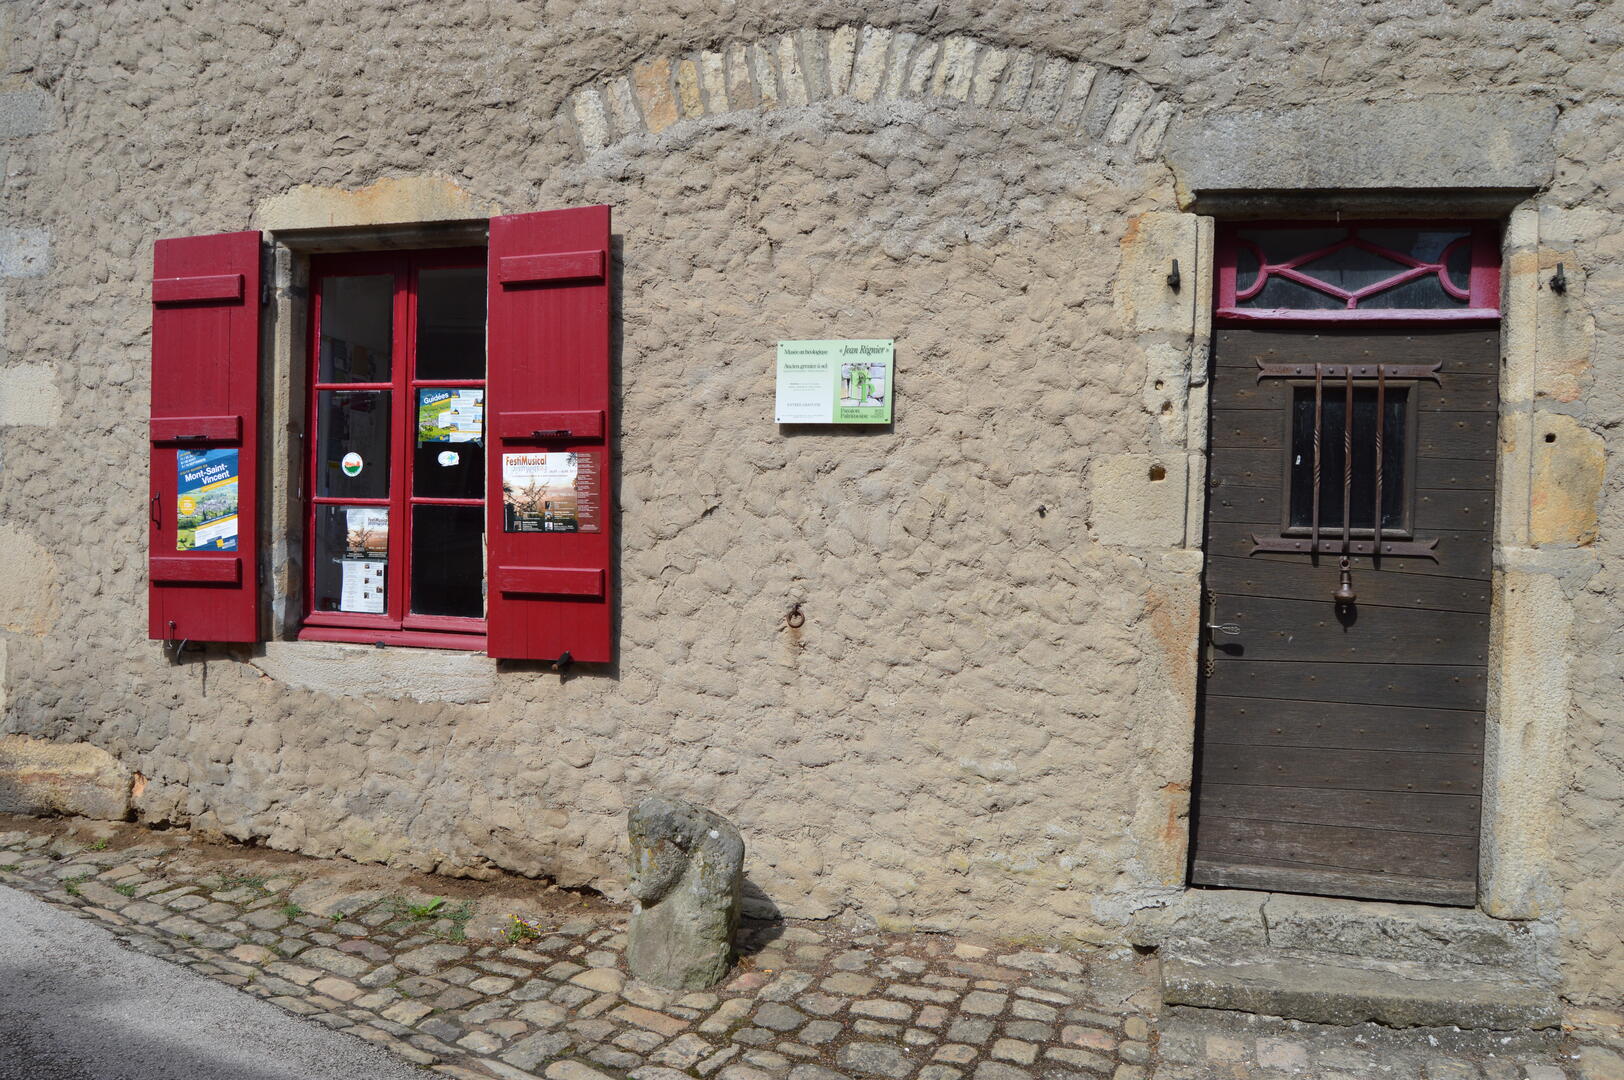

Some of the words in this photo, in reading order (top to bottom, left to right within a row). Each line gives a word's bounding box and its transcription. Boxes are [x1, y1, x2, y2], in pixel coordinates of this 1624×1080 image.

[423, 392, 449, 404] Guidées
[505, 454, 547, 466] FestiMusical
[184, 463, 228, 482] Mont-Saint-
[201, 470, 230, 485] Vincent
